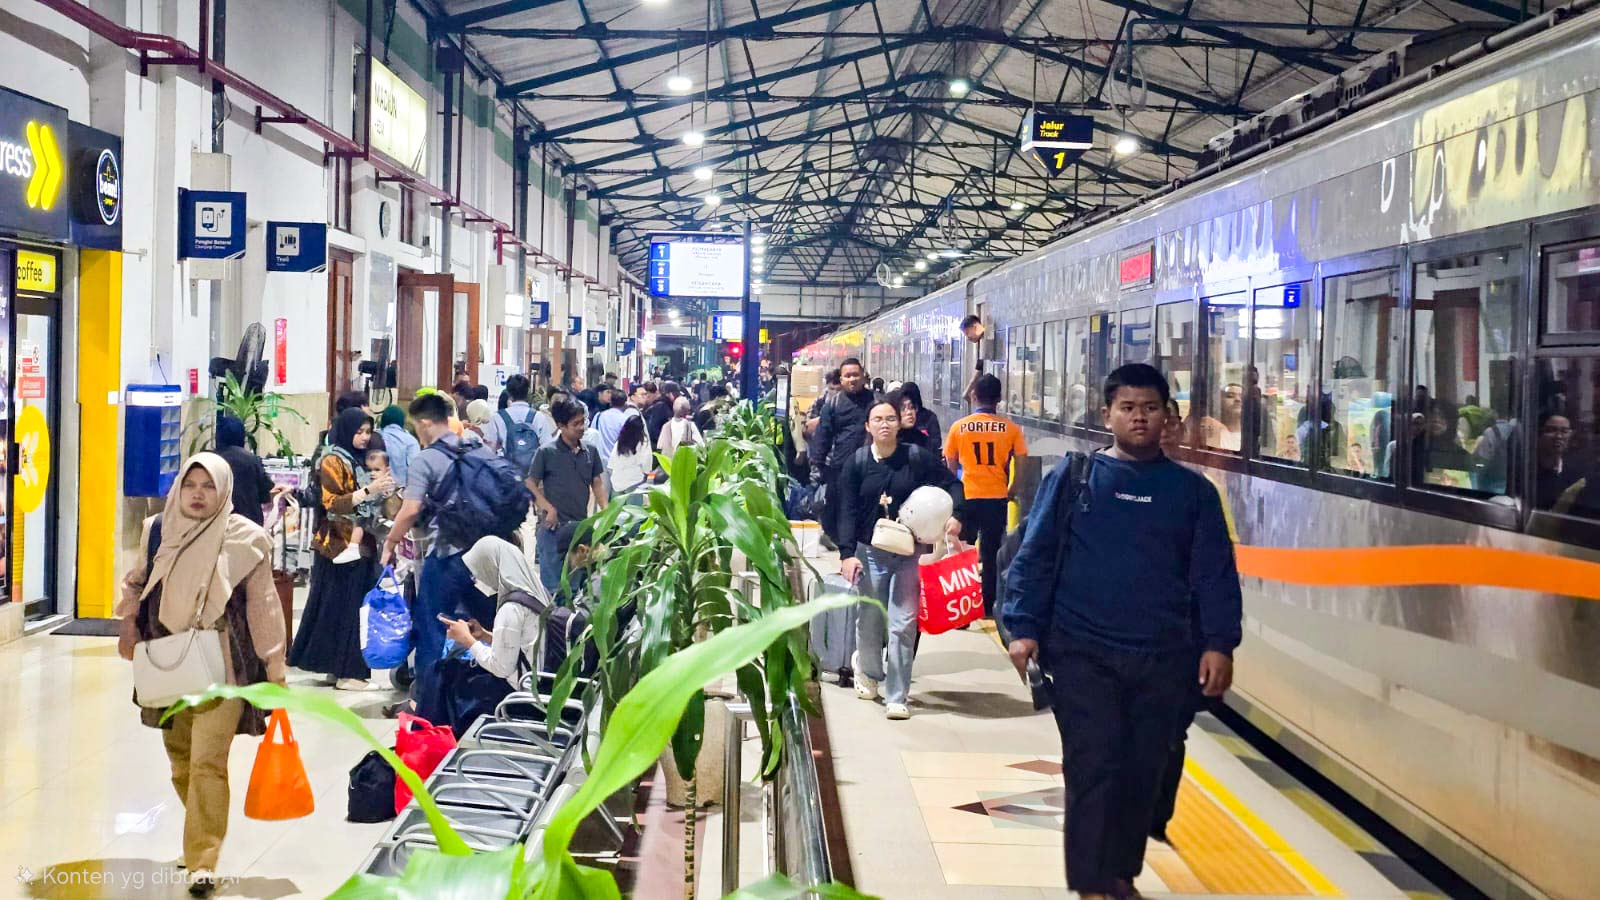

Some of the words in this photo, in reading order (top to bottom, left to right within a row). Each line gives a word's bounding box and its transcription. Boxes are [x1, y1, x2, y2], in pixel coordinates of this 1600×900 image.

[374, 81, 397, 119] MADIUN
[1040, 121, 1064, 130] Jalur
[1054, 152, 1065, 169] 1
[17, 260, 43, 282] coffee
[960, 420, 1006, 433] PORTER
[972, 441, 996, 466] 11
